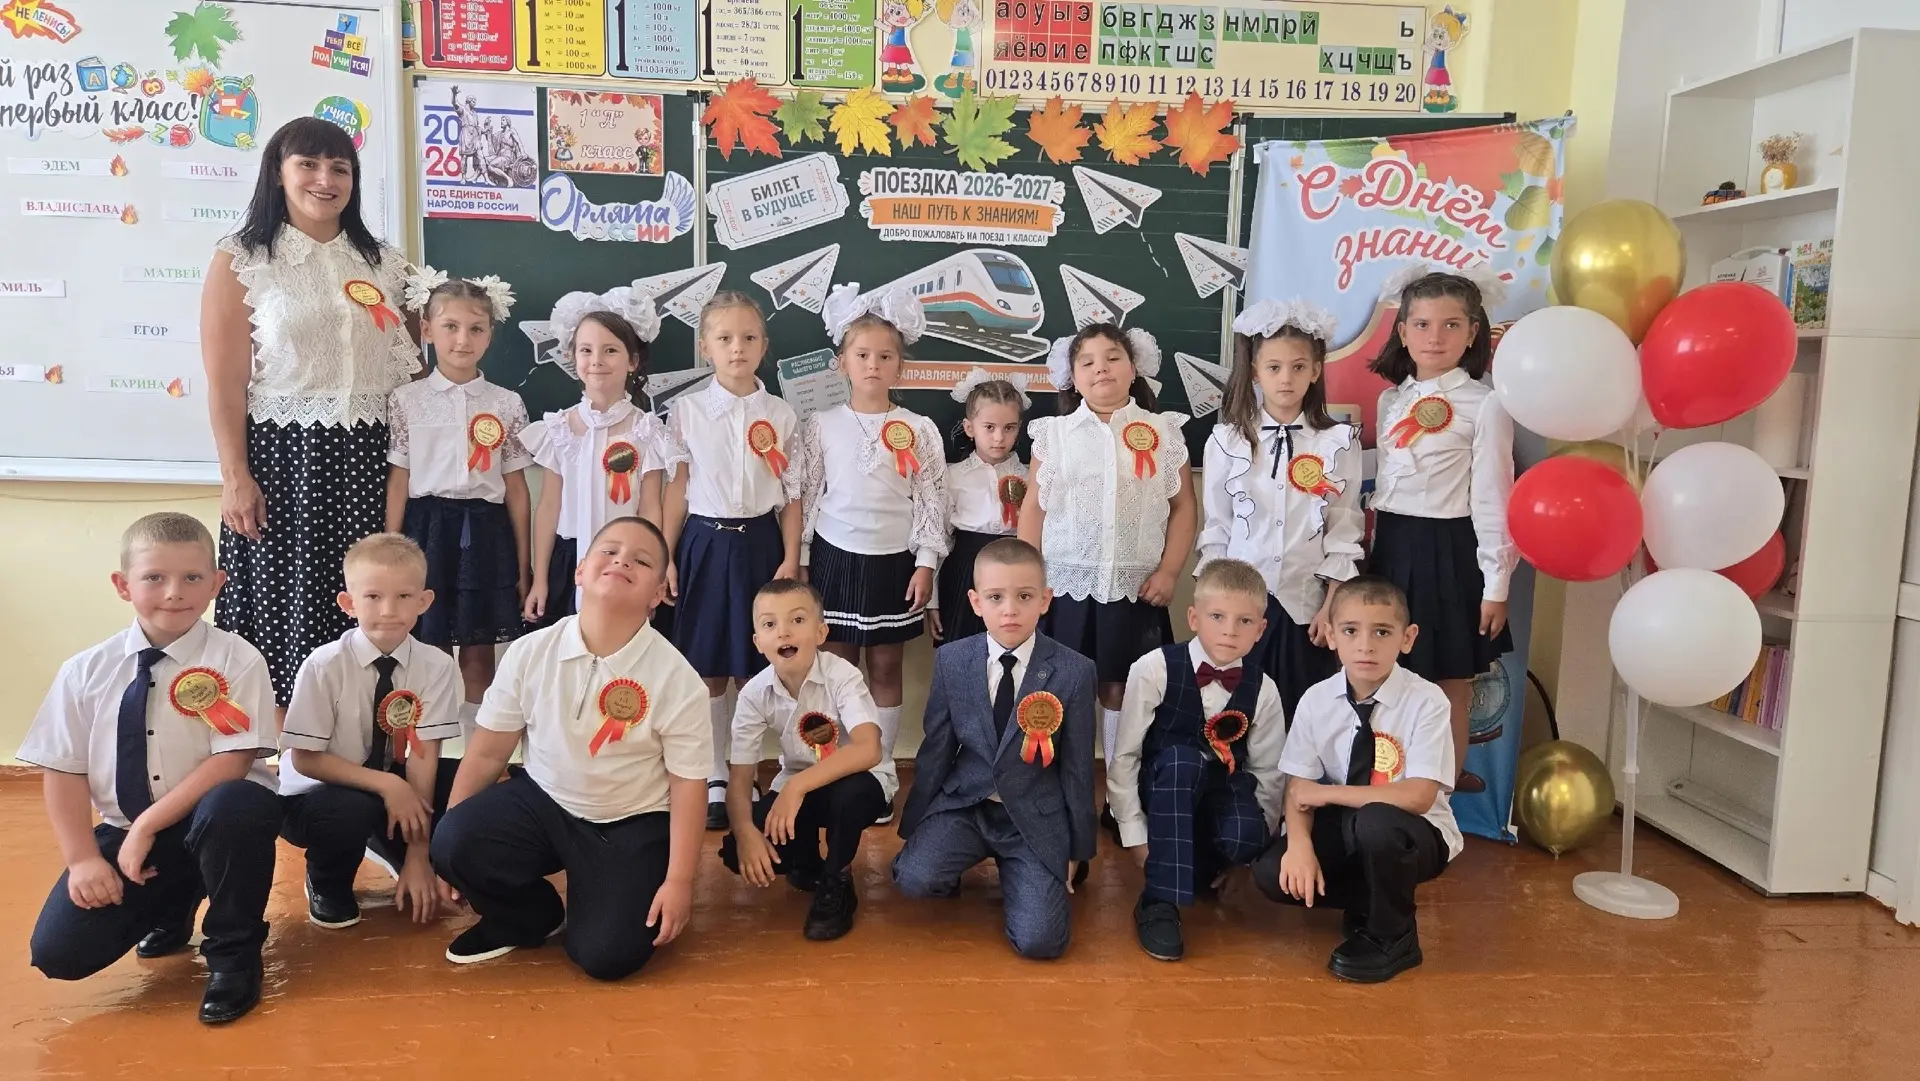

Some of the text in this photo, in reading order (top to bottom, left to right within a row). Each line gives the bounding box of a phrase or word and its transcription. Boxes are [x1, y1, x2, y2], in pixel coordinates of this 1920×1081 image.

[733, 7, 764, 15] 365/366
[15, 7, 71, 37] НЕ ЛЕНИСЬ!
[653, 24, 667, 32] 100
[741, 21, 761, 29] 28/31
[326, 36, 361, 50] ТЕБЯ ВСЁ
[655, 44, 674, 52] 1000
[565, 49, 580, 57] 100
[566, 61, 585, 69] 1000
[24, 63, 74, 100] раз
[1148, 75, 1166, 95] 11
[1176, 76, 1196, 95] 12
[1203, 77, 1224, 97] 13
[1231, 78, 1251, 98] 14
[1258, 79, 1279, 99] 15
[1286, 79, 1306, 100] 16
[1314, 80, 1334, 100] 17
[1341, 81, 1361, 101] 18
[1368, 82, 1388, 102] 19
[1395, 83, 1416, 103] 20
[0, 91, 199, 137] первый класс!
[322, 103, 358, 126] УЧИСЬ
[580, 108, 588, 128] 1
[424, 113, 462, 146] 20
[581, 144, 635, 160] класс
[42, 160, 80, 171] ЭДЕМ
[425, 146, 462, 177] 26
[189, 165, 238, 177] НИАЛЬ
[751, 175, 801, 202] БИЛЕТ
[874, 170, 1052, 200] ПОЕЗДКА 2026-2027
[427, 189, 503, 200] ГОД ЕДИНСТВА
[26, 201, 120, 214] ВЛАДИСЛАВА
[427, 200, 519, 212] НАРОДОВ РОССИИ
[541, 172, 670, 233] Орлята
[741, 188, 817, 222] В БУДУЩЕЕ
[1297, 160, 1506, 248] С Днём
[191, 207, 240, 220] ТИМУР
[893, 203, 1039, 225] НАШ ПУТЬ К ЗНАНИЯМ!
[883, 228, 910, 237] ДОБРО
[912, 229, 965, 240] ПОЖАЛОВАТЬ
[967, 232, 978, 240] НА
[980, 232, 1005, 242] ПОЕЗД
[1012, 234, 1045, 243] КЛАССА!
[144, 267, 201, 278] МАТВЕЙ
[0, 282, 42, 293] МИЛЬ
[133, 325, 168, 336] ЕГОР
[898, 368, 969, 382] АПРАВЛЯЕМС
[110, 379, 166, 390] КАРИНА
